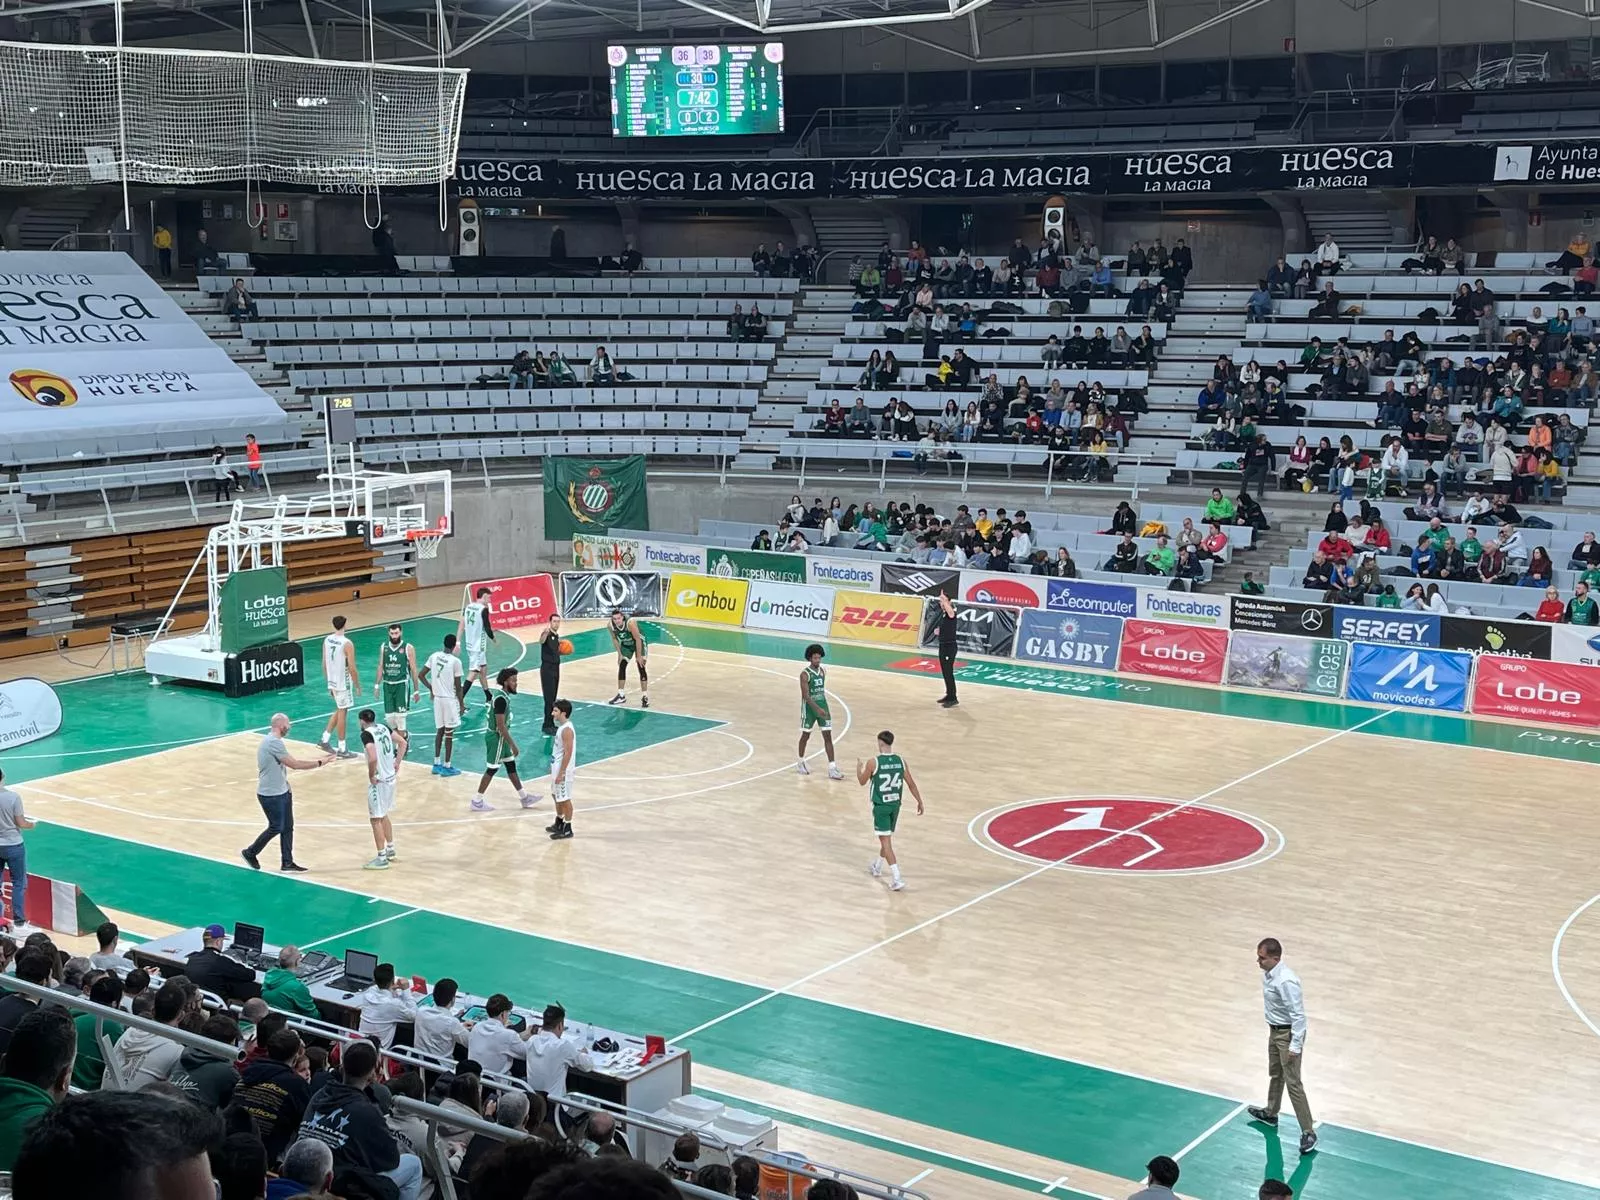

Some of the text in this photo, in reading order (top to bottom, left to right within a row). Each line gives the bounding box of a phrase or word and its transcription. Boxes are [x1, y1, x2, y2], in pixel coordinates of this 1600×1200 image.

[678, 49, 714, 61] 36 38
[687, 91, 711, 105] 7:42
[706, 111, 712, 122] 2
[1124, 153, 1232, 176] Huesca
[1280, 147, 1394, 172] Huesca
[575, 169, 686, 191] Huesca
[693, 172, 722, 191] La
[849, 165, 957, 190] Huesca
[964, 167, 995, 188] La
[1535, 164, 1556, 179] de
[1144, 180, 1161, 192] La
[1297, 176, 1315, 189] La
[458, 186, 474, 197] La
[0, 290, 160, 322] esca
[79, 370, 190, 385] DIPUTACIÓN
[88, 382, 199, 396] HUESCA
[645, 546, 701, 566] Fontecabras
[813, 562, 874, 582] Fontecabras
[244, 595, 286, 610] Lobe
[487, 595, 541, 614] Lobe
[675, 589, 737, 611] embou
[1068, 598, 1134, 614] ecomputer
[1146, 593, 1221, 617] Fontecabras
[244, 607, 286, 622] Huesca
[750, 597, 829, 621] doméstica
[1235, 609, 1274, 619] Concesionario
[839, 606, 912, 631] DHL
[1235, 617, 1277, 628] Mercedes-Benz
[1143, 627, 1165, 636] GRUPO
[1340, 618, 1430, 641] SERFEY
[1025, 636, 1110, 665] GASBY
[1140, 642, 1206, 663] Lobe
[1321, 644, 1342, 656] Hu
[240, 657, 299, 684] Huesca
[1318, 655, 1339, 670] es
[1500, 663, 1527, 673] GRUPO
[966, 664, 1152, 692] Ayuntamiento
[984, 673, 1092, 692] Huesca
[1316, 674, 1337, 688] ca
[1372, 690, 1436, 706] movicoders
[1496, 681, 1581, 705] Lobe
[878, 772, 903, 792] 24
